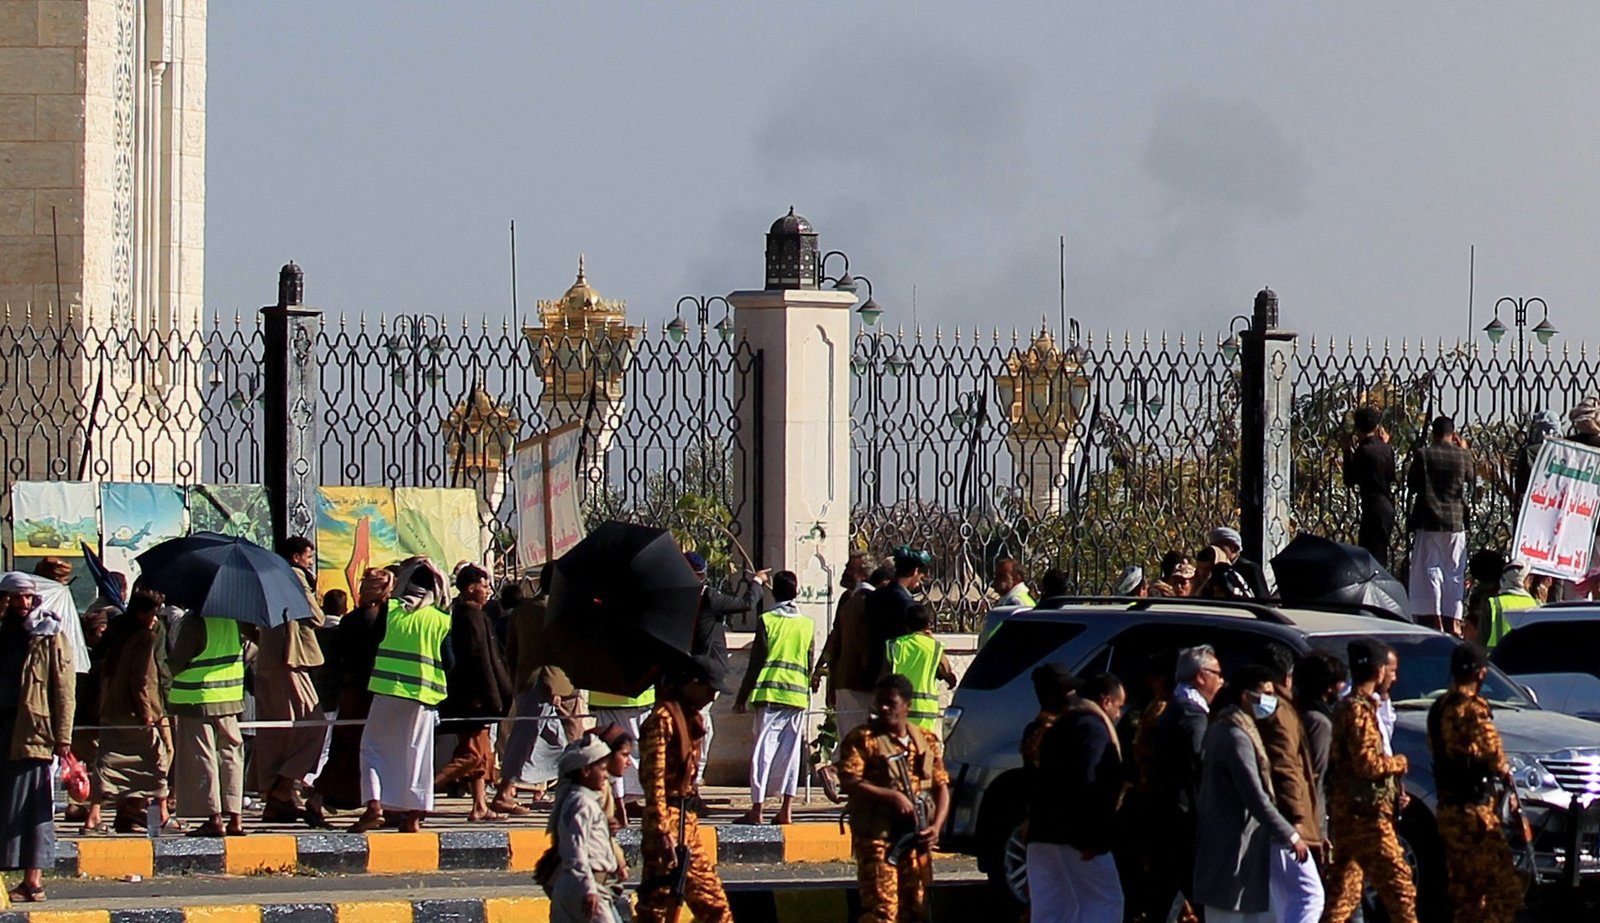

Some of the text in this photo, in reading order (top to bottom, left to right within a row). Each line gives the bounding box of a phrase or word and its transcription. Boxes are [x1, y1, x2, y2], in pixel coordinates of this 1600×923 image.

[1543, 451, 1600, 485] اطعوا
[1567, 493, 1599, 520] البضائع
[1553, 517, 1562, 535] و
